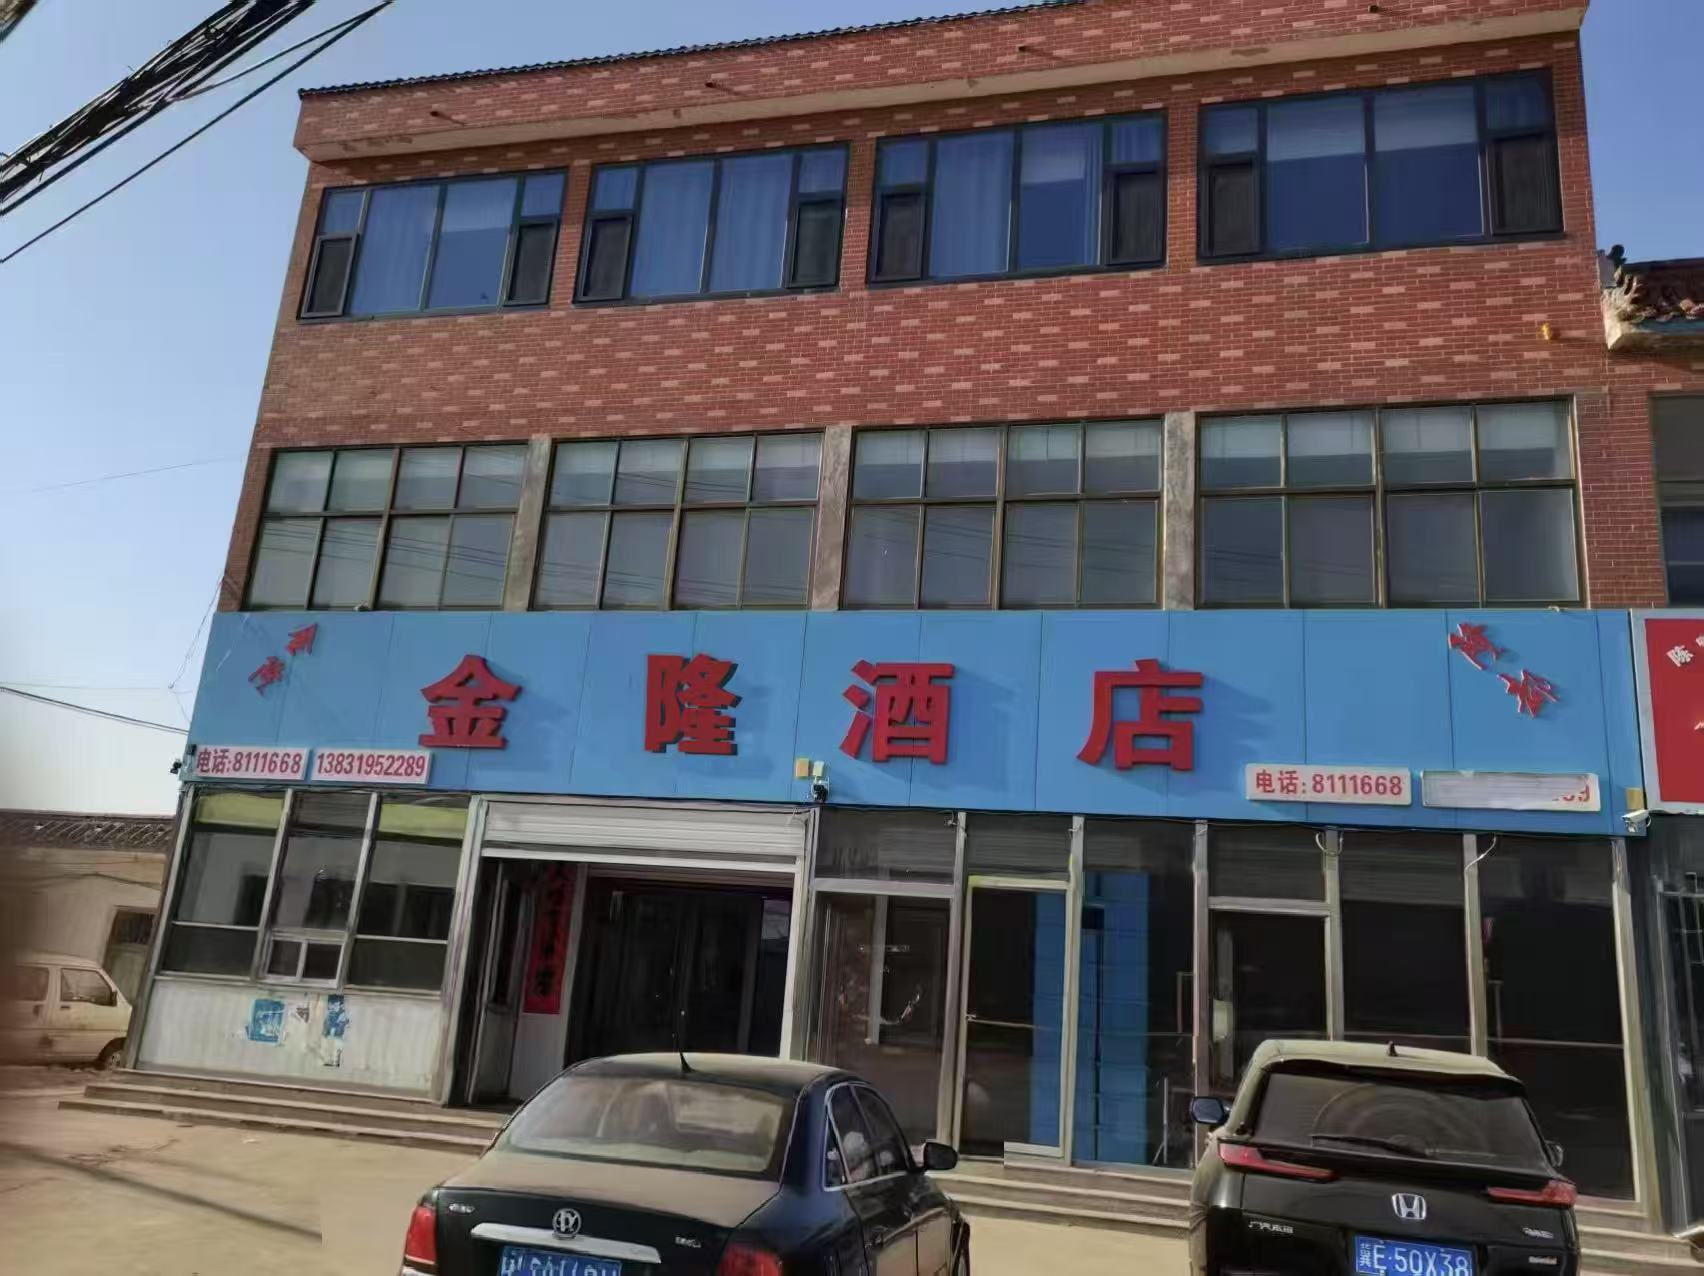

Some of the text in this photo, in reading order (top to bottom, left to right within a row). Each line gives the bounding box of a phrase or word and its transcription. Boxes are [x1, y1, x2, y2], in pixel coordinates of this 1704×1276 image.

[419, 654, 1204, 771] 金隆酒店
[197, 748, 302, 775] 电话:8111668
[316, 752, 426, 777] 13831952289
[1255, 769, 1403, 796] 电话:8111668
